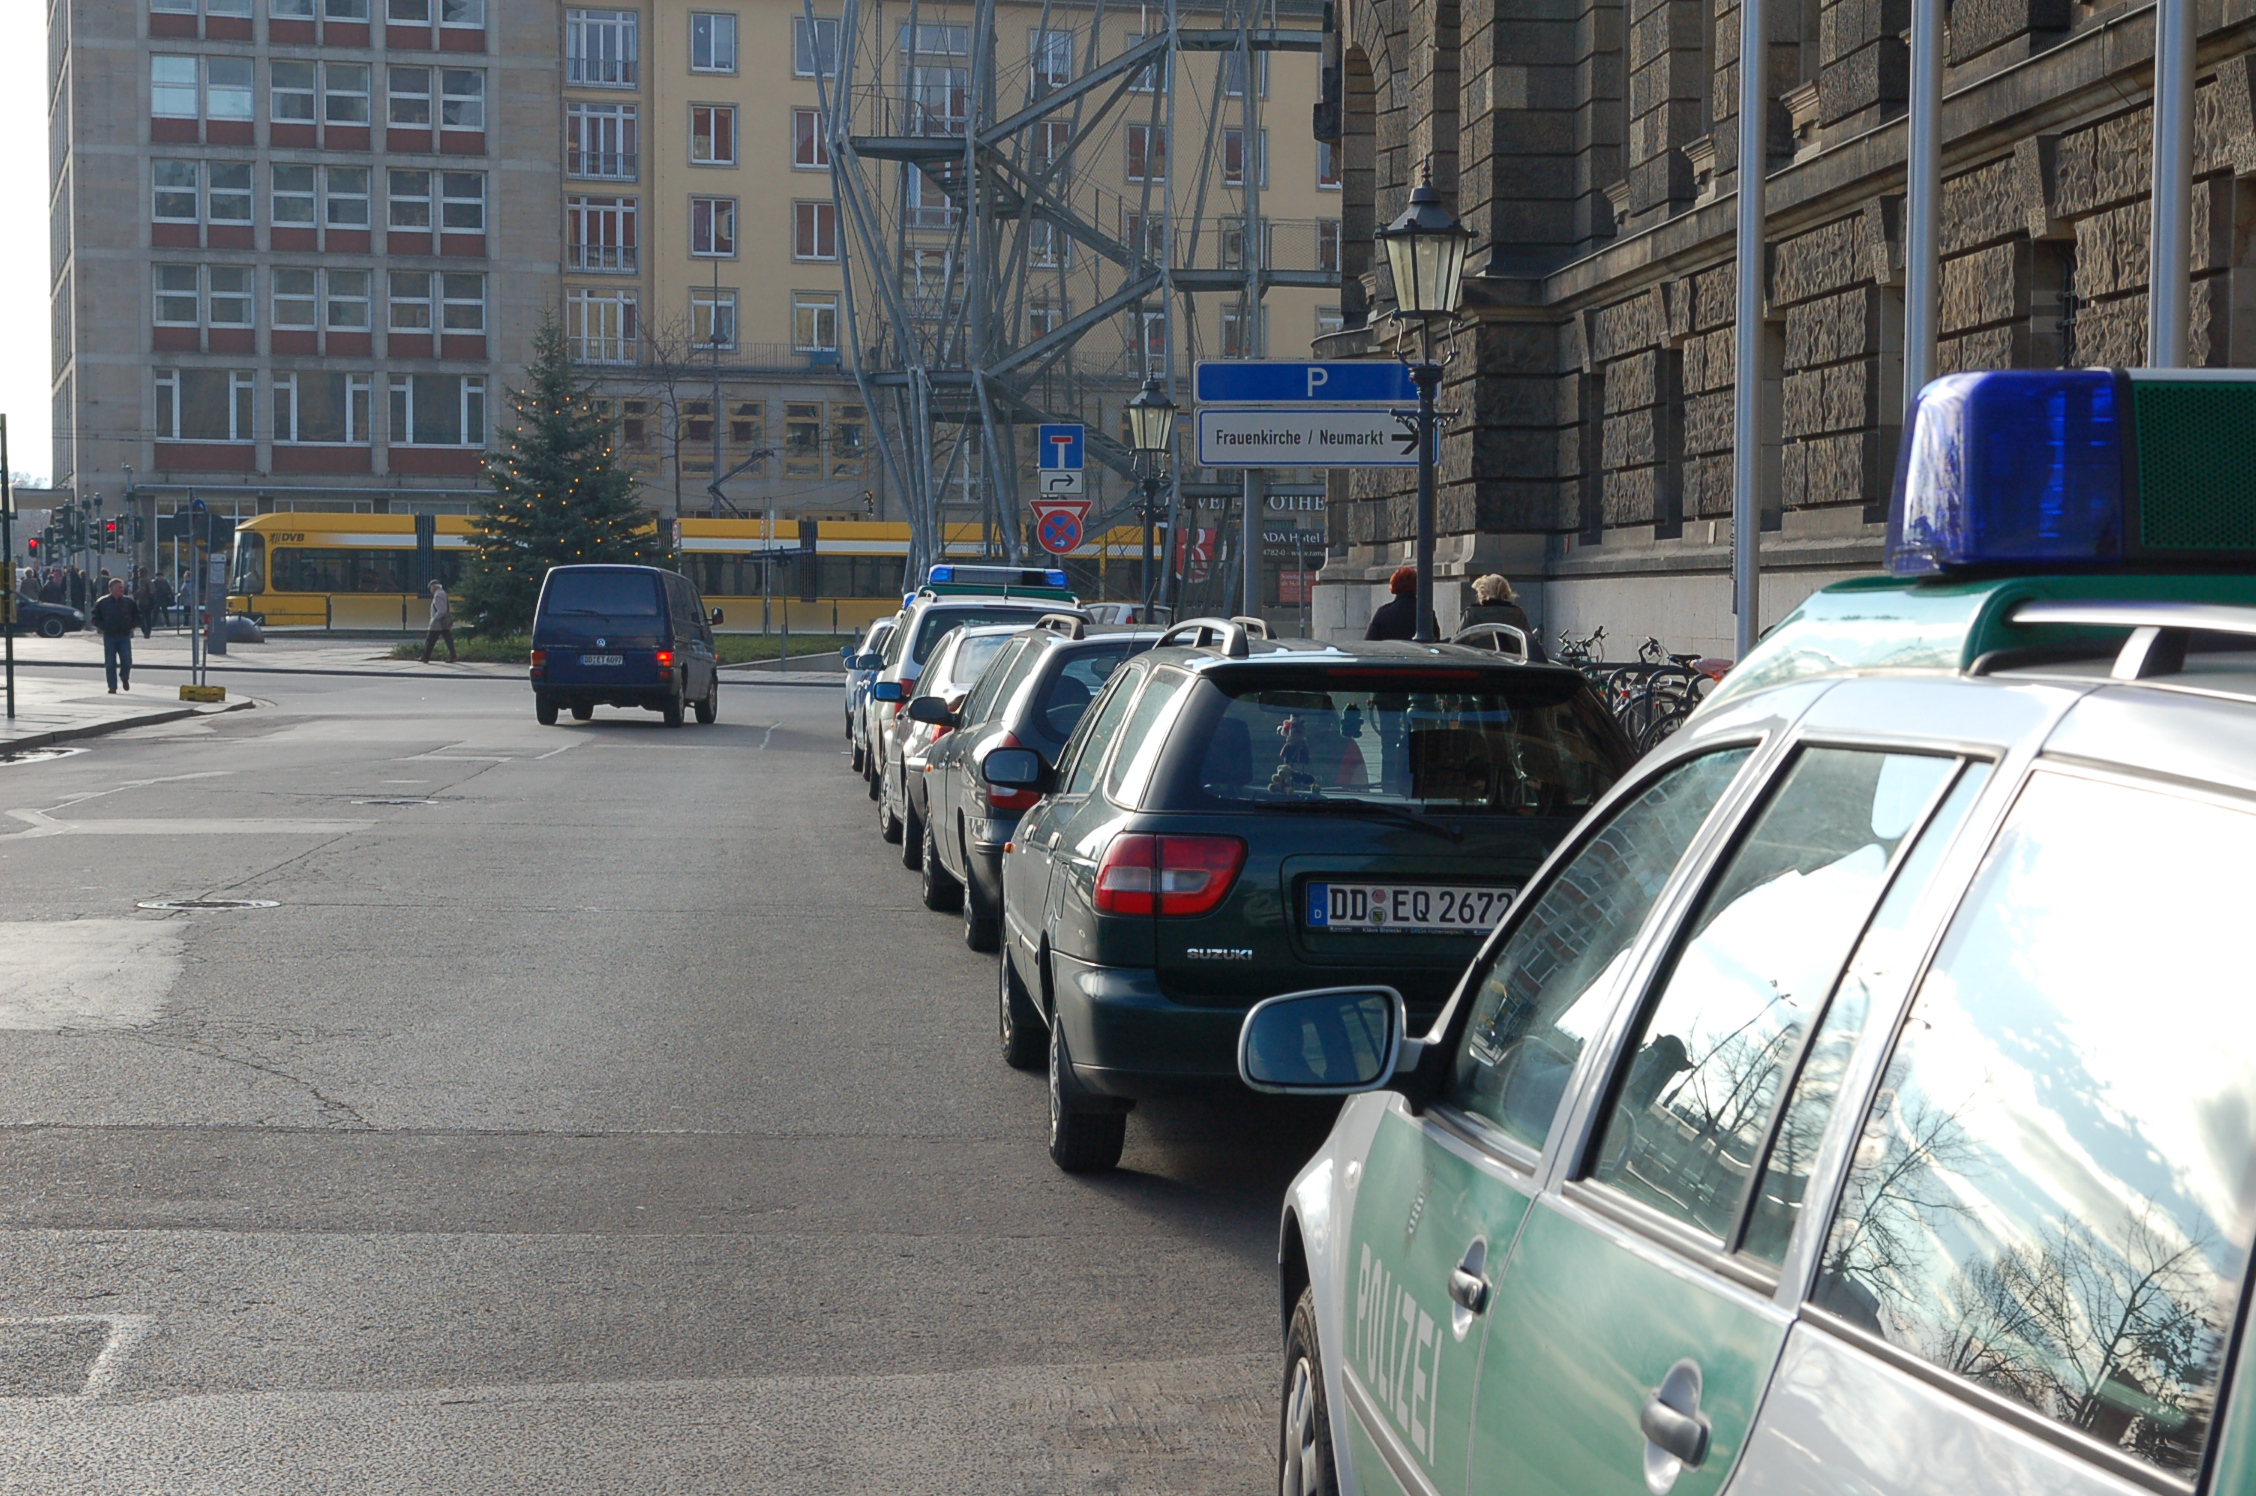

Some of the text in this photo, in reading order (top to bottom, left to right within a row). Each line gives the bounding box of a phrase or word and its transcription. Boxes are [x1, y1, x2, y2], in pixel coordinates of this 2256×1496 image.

[1307, 367, 1328, 397] P
[1215, 429, 1384, 446] Frauenkirche / Neumarkt
[281, 532, 305, 542] DVB
[1289, 532, 1320, 543] Htel
[1314, 909, 1322, 919] D
[1329, 888, 1515, 925] DD EQ 2672
[1186, 948, 1253, 961] SUZUKI
[1355, 1241, 1444, 1467] POLIZEI
